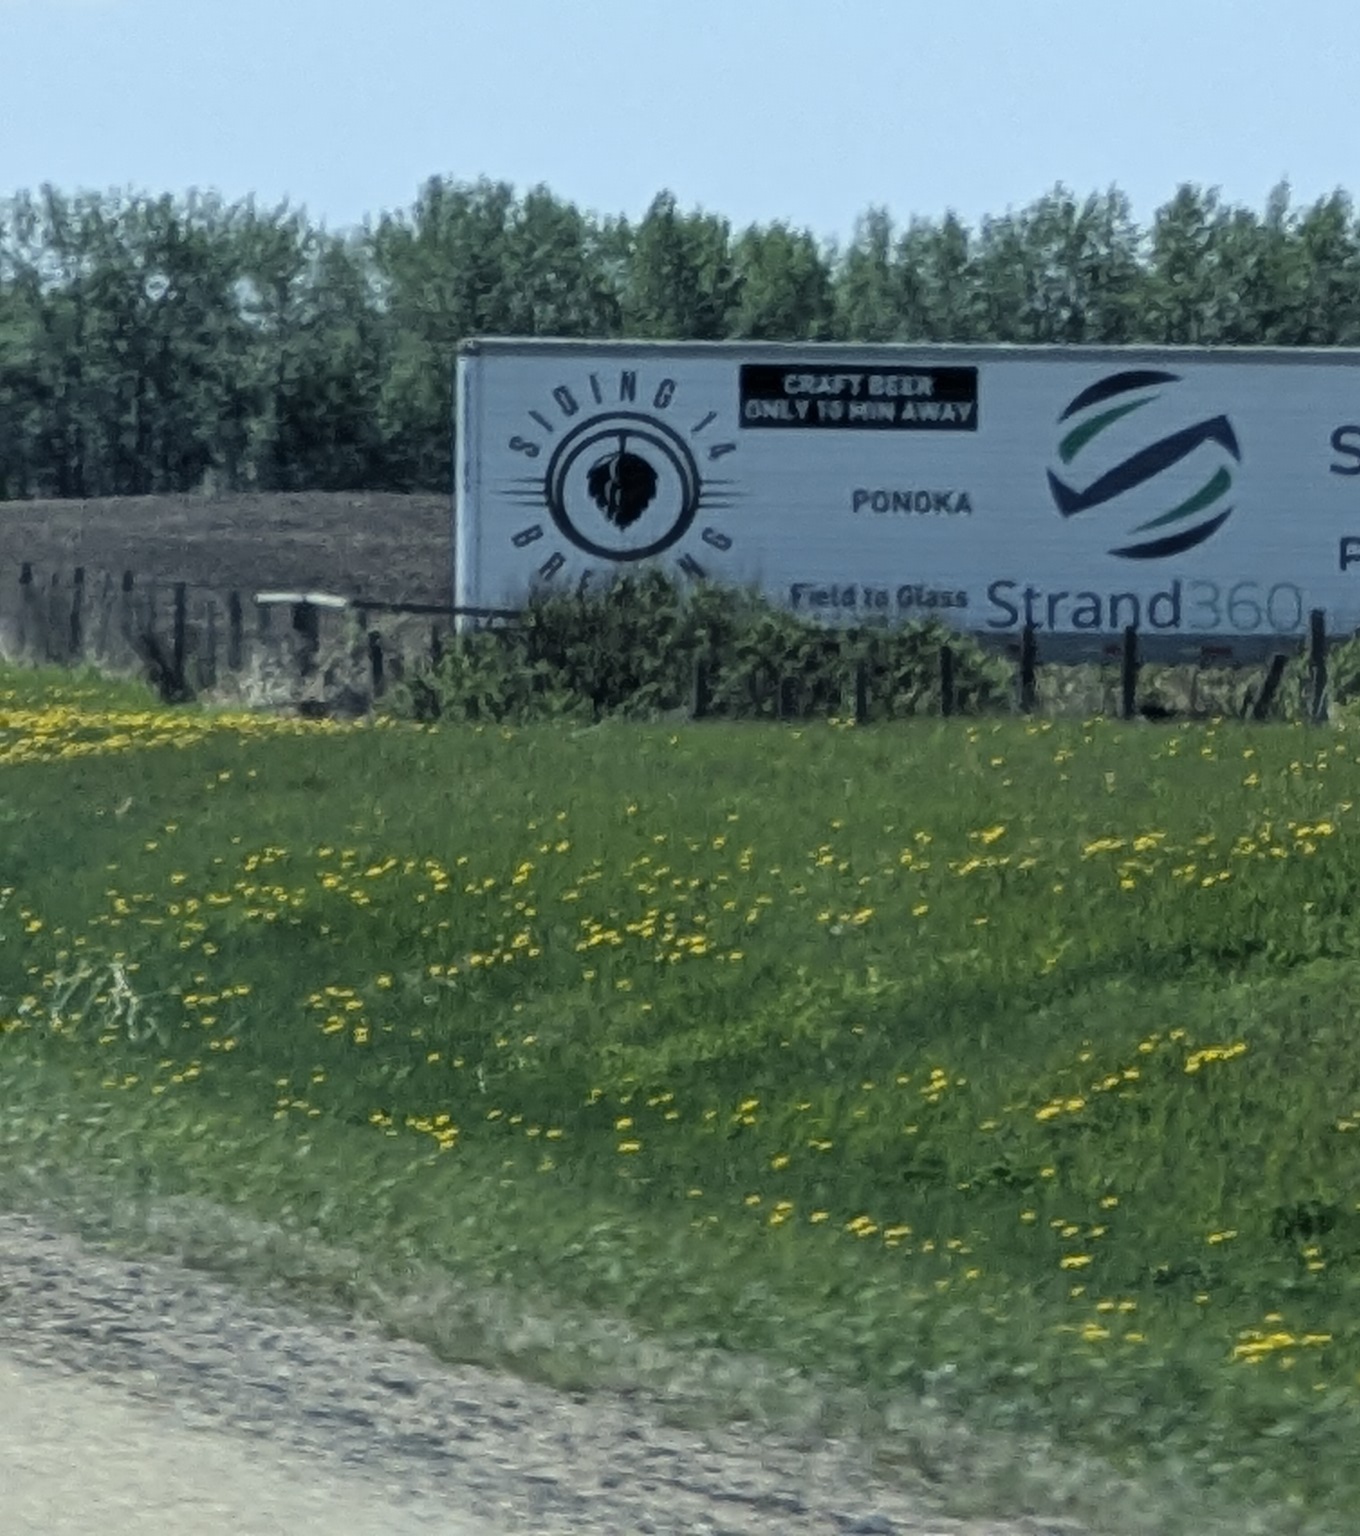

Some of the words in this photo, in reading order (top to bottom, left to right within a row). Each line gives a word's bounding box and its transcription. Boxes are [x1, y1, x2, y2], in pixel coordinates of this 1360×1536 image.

[782, 373, 864, 396] CRAFT
[867, 375, 934, 397] BEER
[509, 370, 678, 458] SIDING
[744, 398, 810, 421] ONLY
[848, 400, 896, 423] MIN
[900, 400, 974, 422] AWAY
[852, 487, 973, 516] PONOKA
[790, 582, 856, 609] Field
[863, 585, 890, 608] to
[896, 583, 969, 608] Glass
